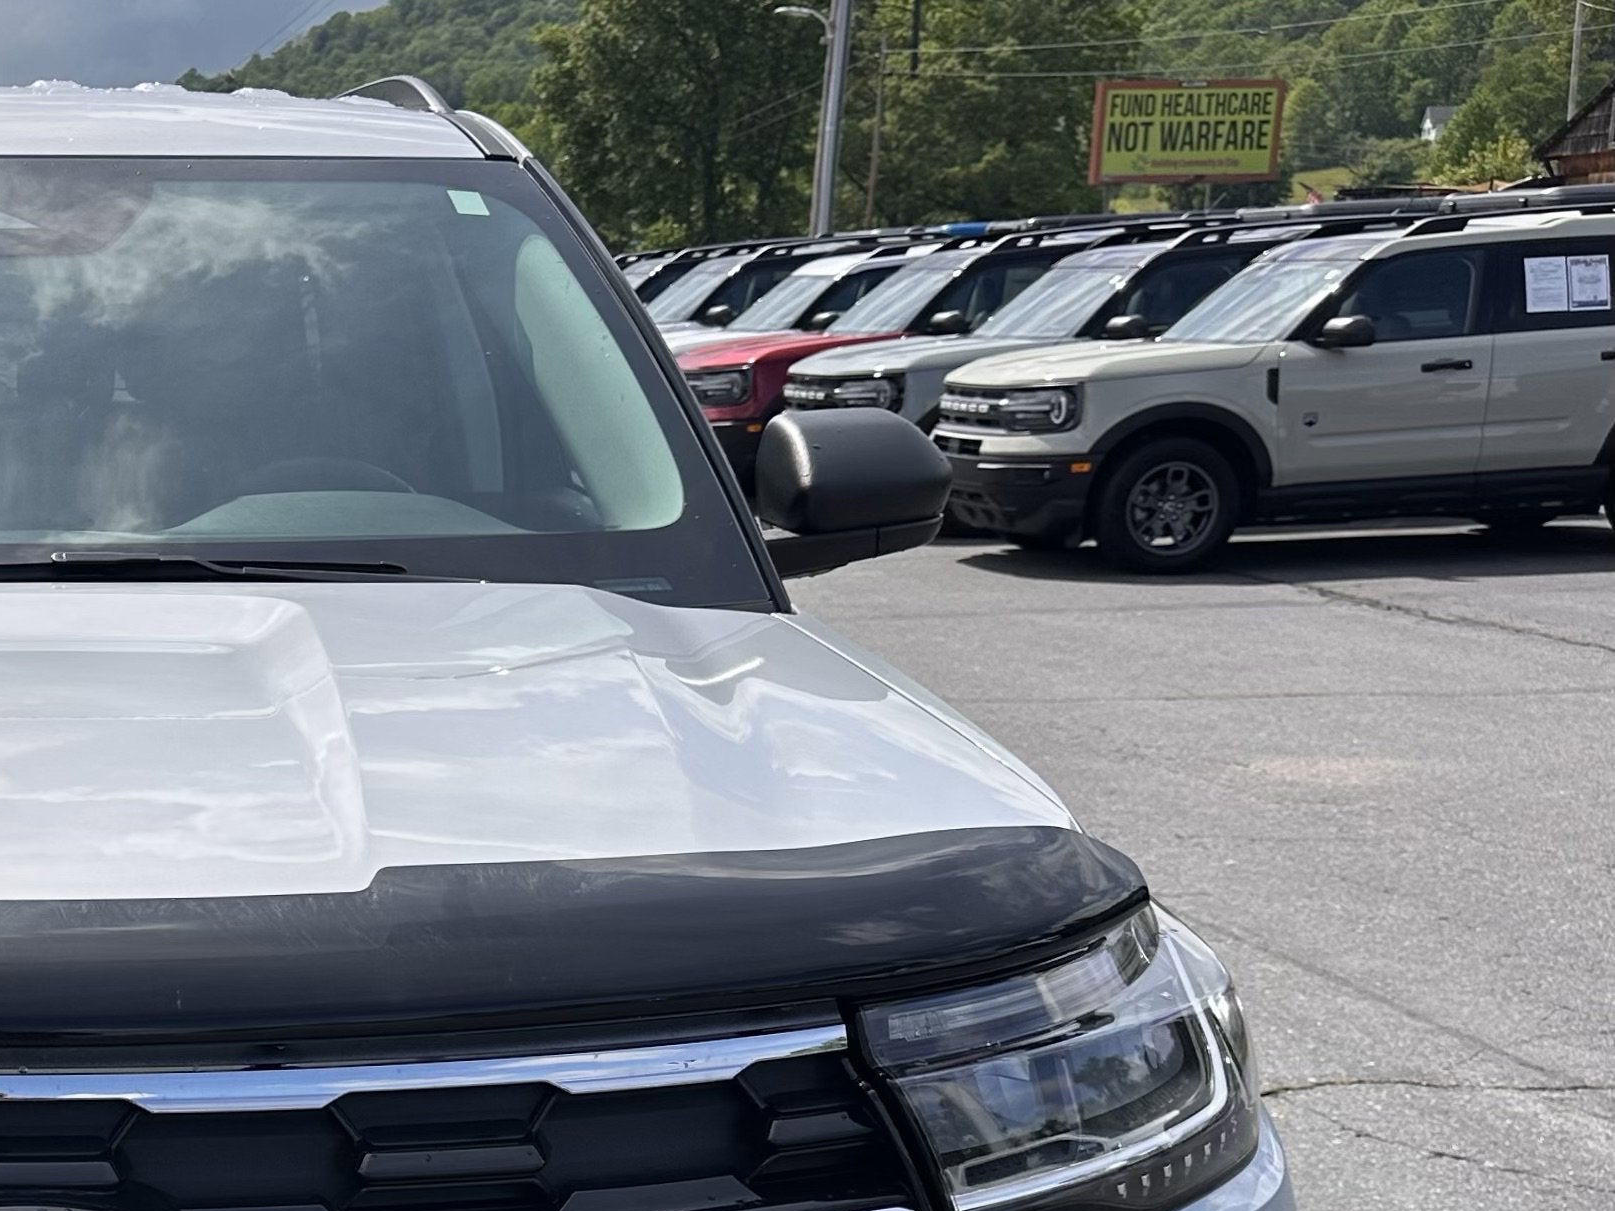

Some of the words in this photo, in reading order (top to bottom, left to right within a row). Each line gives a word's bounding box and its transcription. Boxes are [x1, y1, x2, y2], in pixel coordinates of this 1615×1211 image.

[1109, 93, 1156, 117] FUND
[1160, 91, 1274, 116] HEALTHCARE
[1106, 121, 1154, 152] NOT
[1159, 119, 1271, 151] WARFARE
